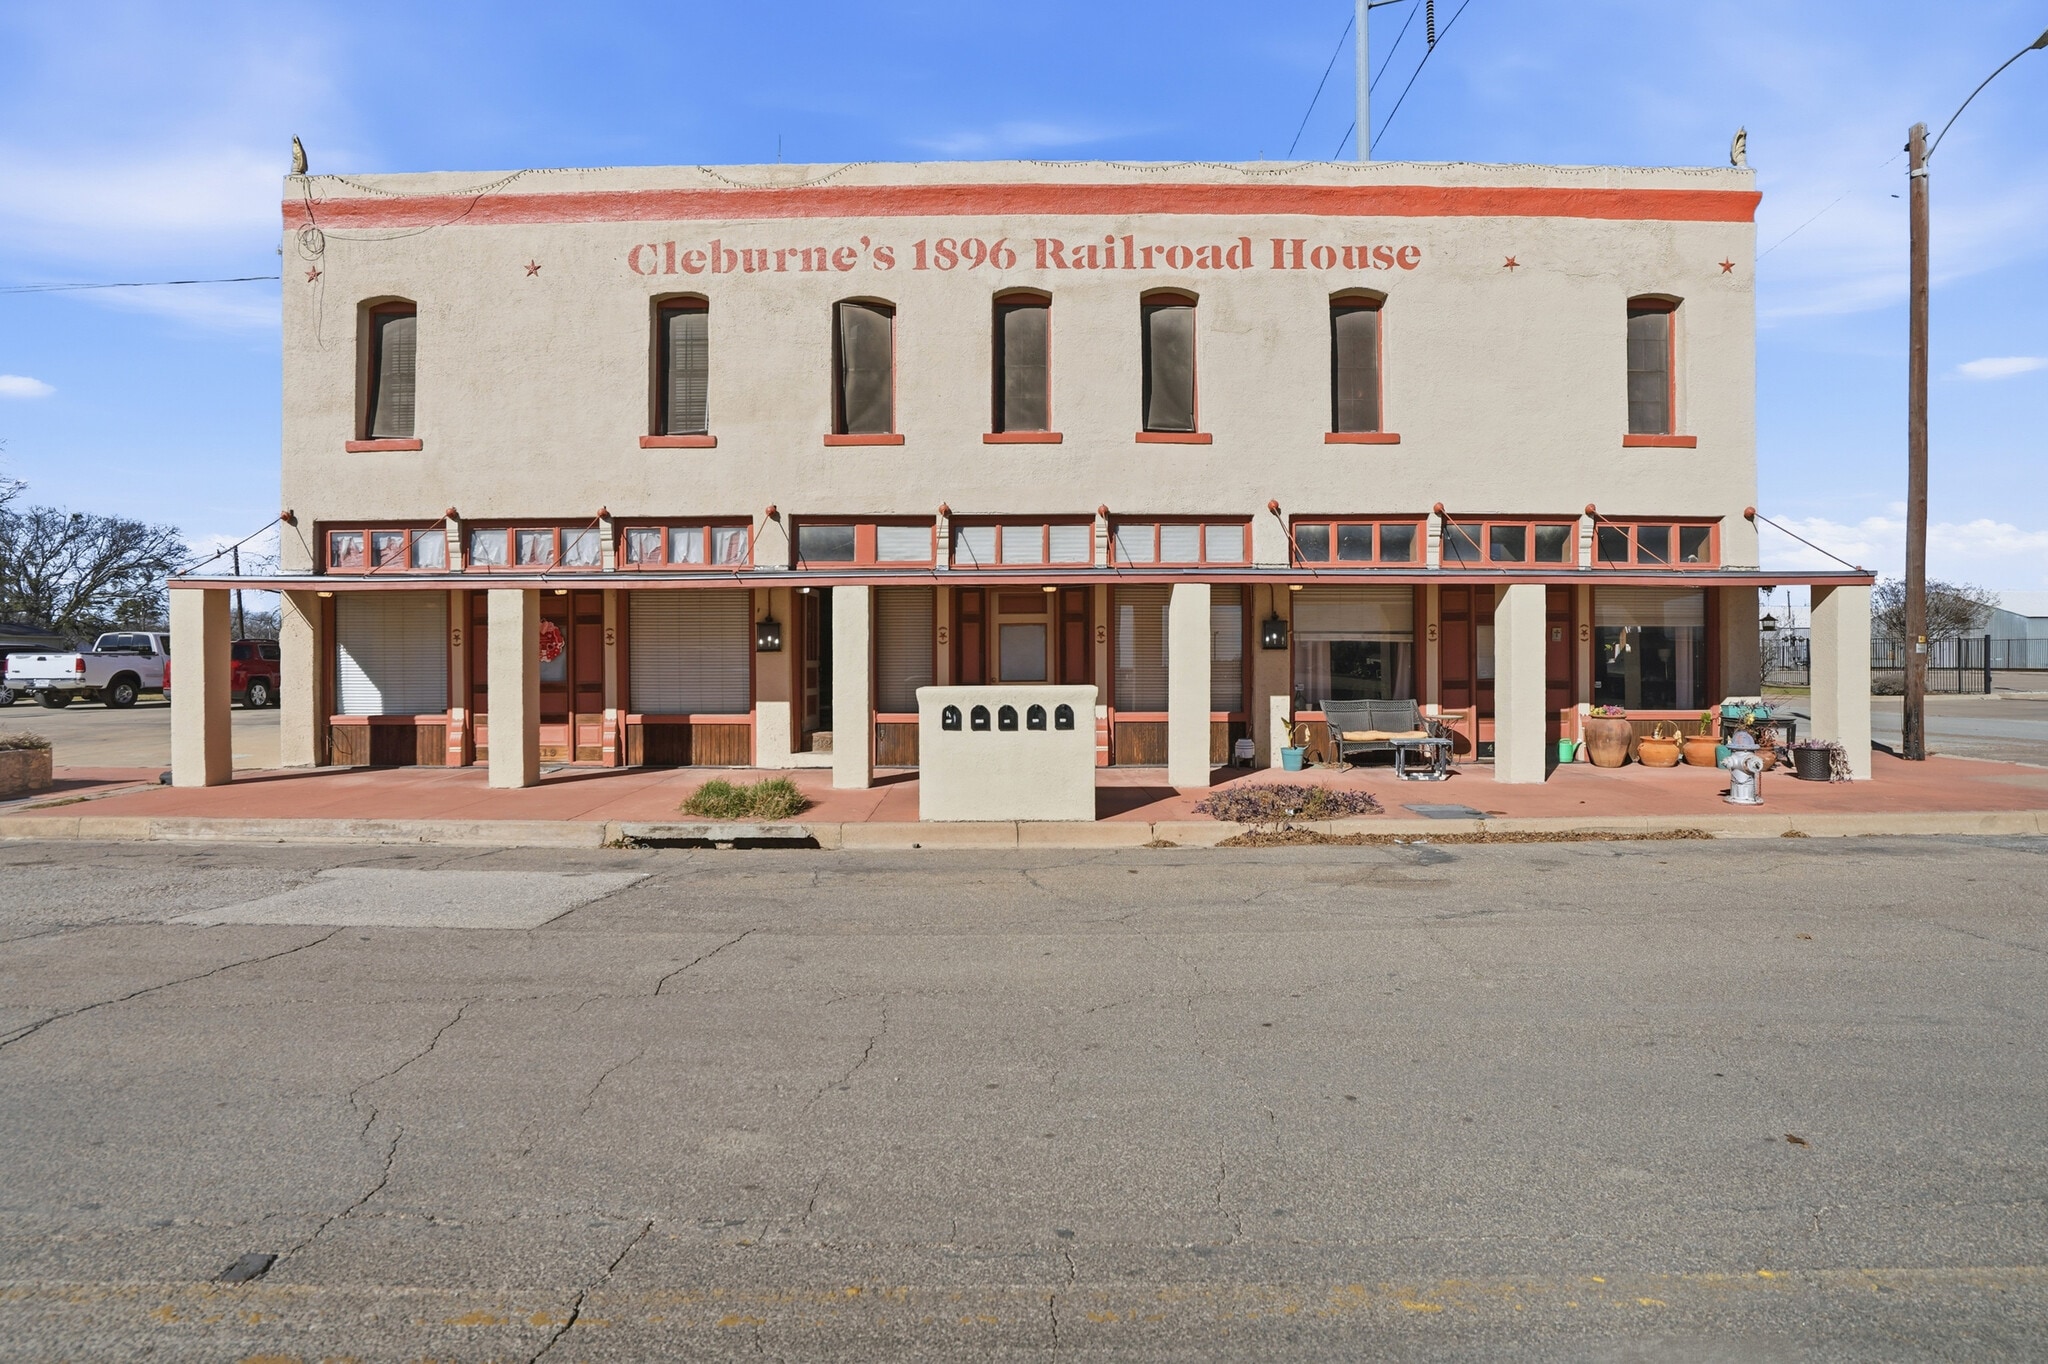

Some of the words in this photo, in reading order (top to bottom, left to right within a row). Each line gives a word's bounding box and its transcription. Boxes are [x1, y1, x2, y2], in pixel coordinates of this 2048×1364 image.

[627, 235, 895, 275] Cleburne's
[911, 237, 1017, 271] 1896
[1033, 234, 1254, 270] Railroad
[1270, 237, 1421, 271] House
